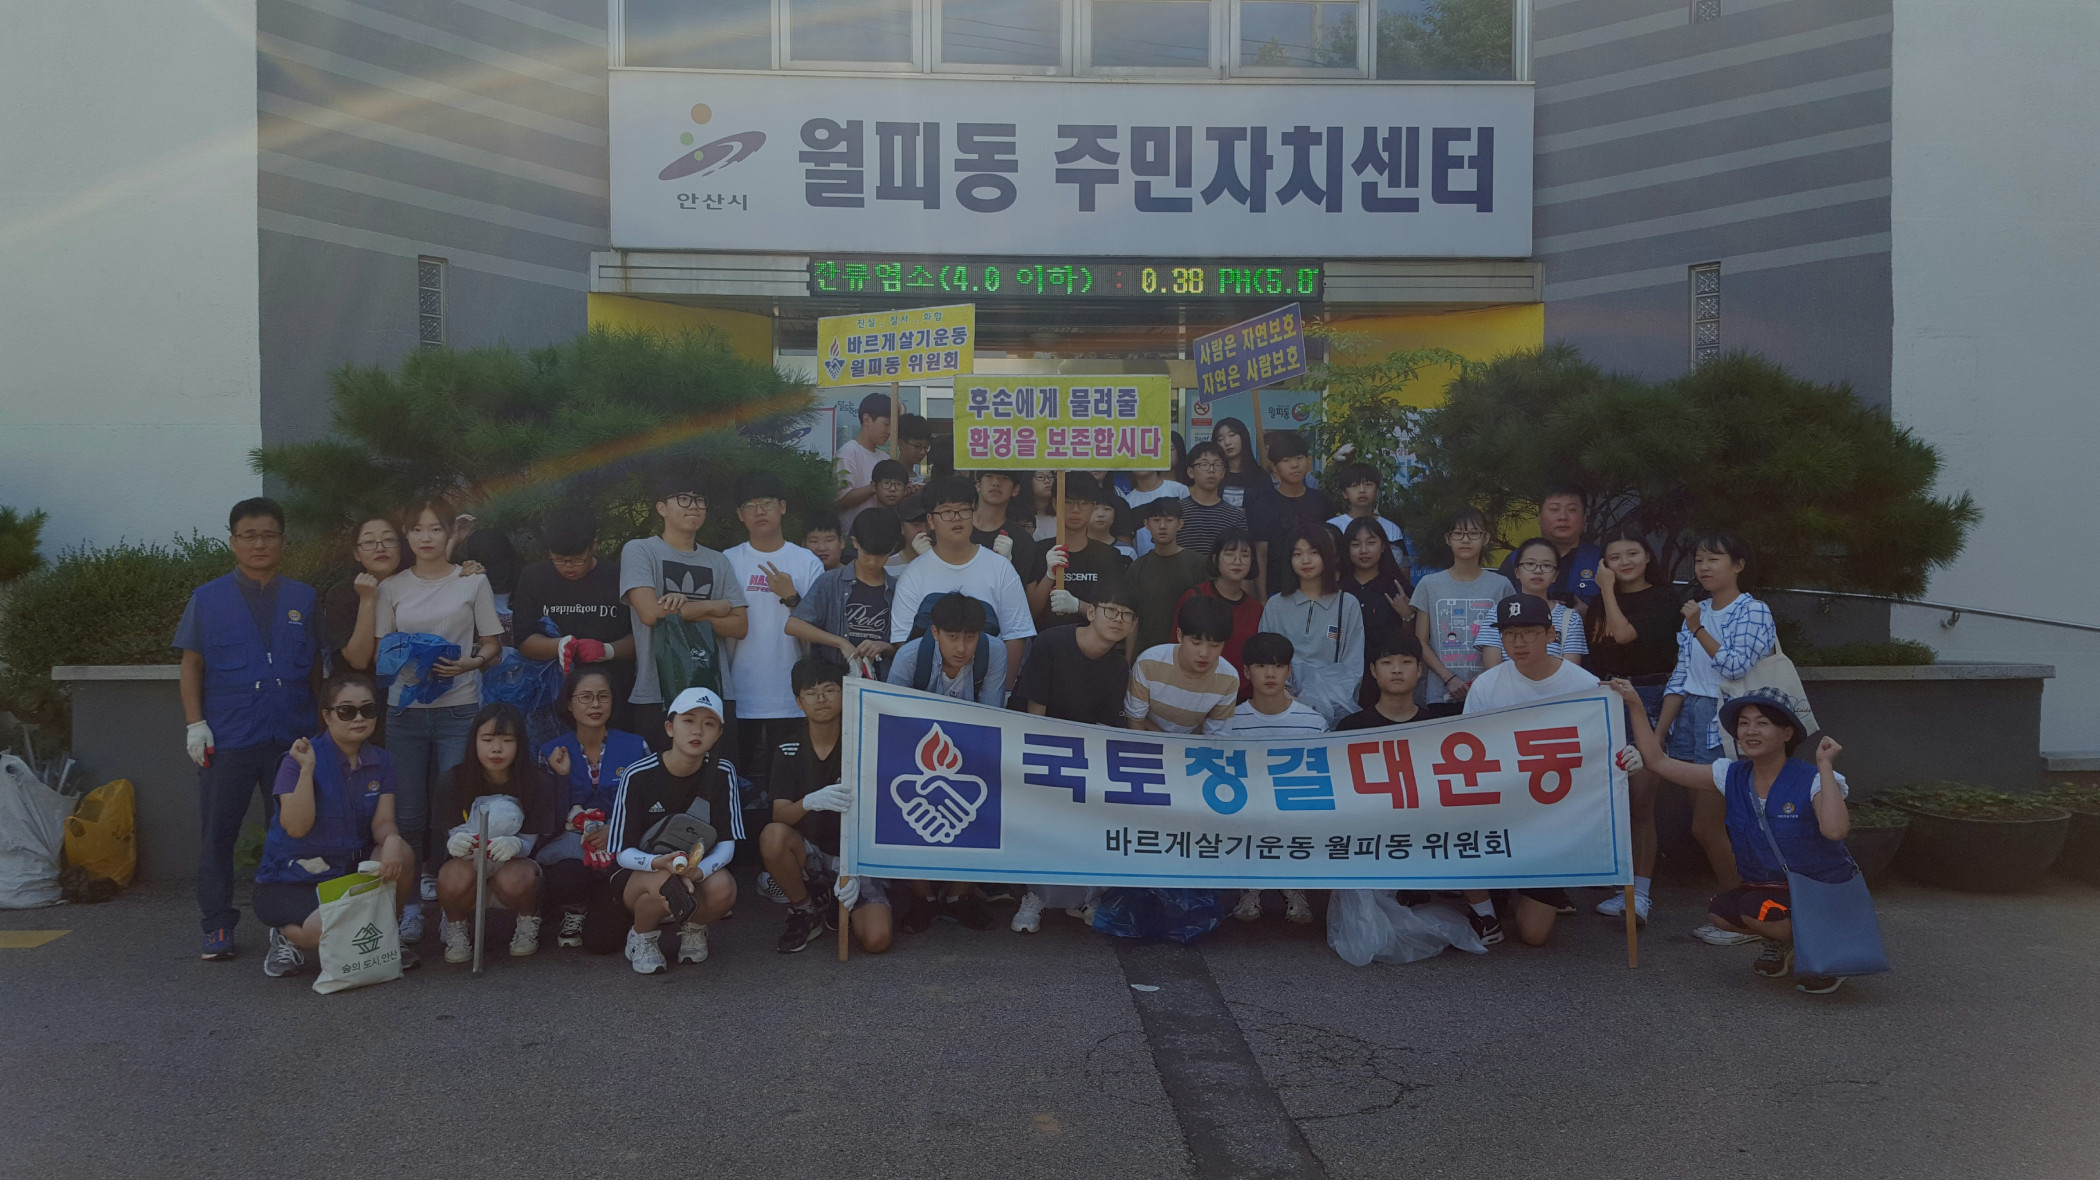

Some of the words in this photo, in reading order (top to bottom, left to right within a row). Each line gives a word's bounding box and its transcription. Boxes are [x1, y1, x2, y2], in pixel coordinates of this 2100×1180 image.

[799, 117, 1019, 214] 월피동
[1054, 124, 1495, 214] 주민자치센터
[676, 192, 748, 211] 안산시
[1141, 267, 1204, 294] 0.38
[846, 326, 968, 354] 바르게살기운동
[1200, 333, 1237, 366] 사람은
[1241, 313, 1297, 351] 자연보호
[850, 355, 900, 378] 월피동
[908, 351, 959, 374] 위원회
[1202, 364, 1241, 396] 자연은
[1246, 345, 1301, 382] 사람보호
[969, 388, 1058, 418] 후손에게
[1070, 388, 1138, 418] 물려줄
[969, 428, 1036, 458] 환경을
[1047, 427, 1161, 458] 보존합시다
[1064, 573, 1098, 582] ESCENTE
[846, 603, 889, 631] Polo
[1105, 827, 1315, 861] 바르게살기운동
[1324, 833, 1412, 861] 월피동
[1422, 829, 1513, 861] 위원회
